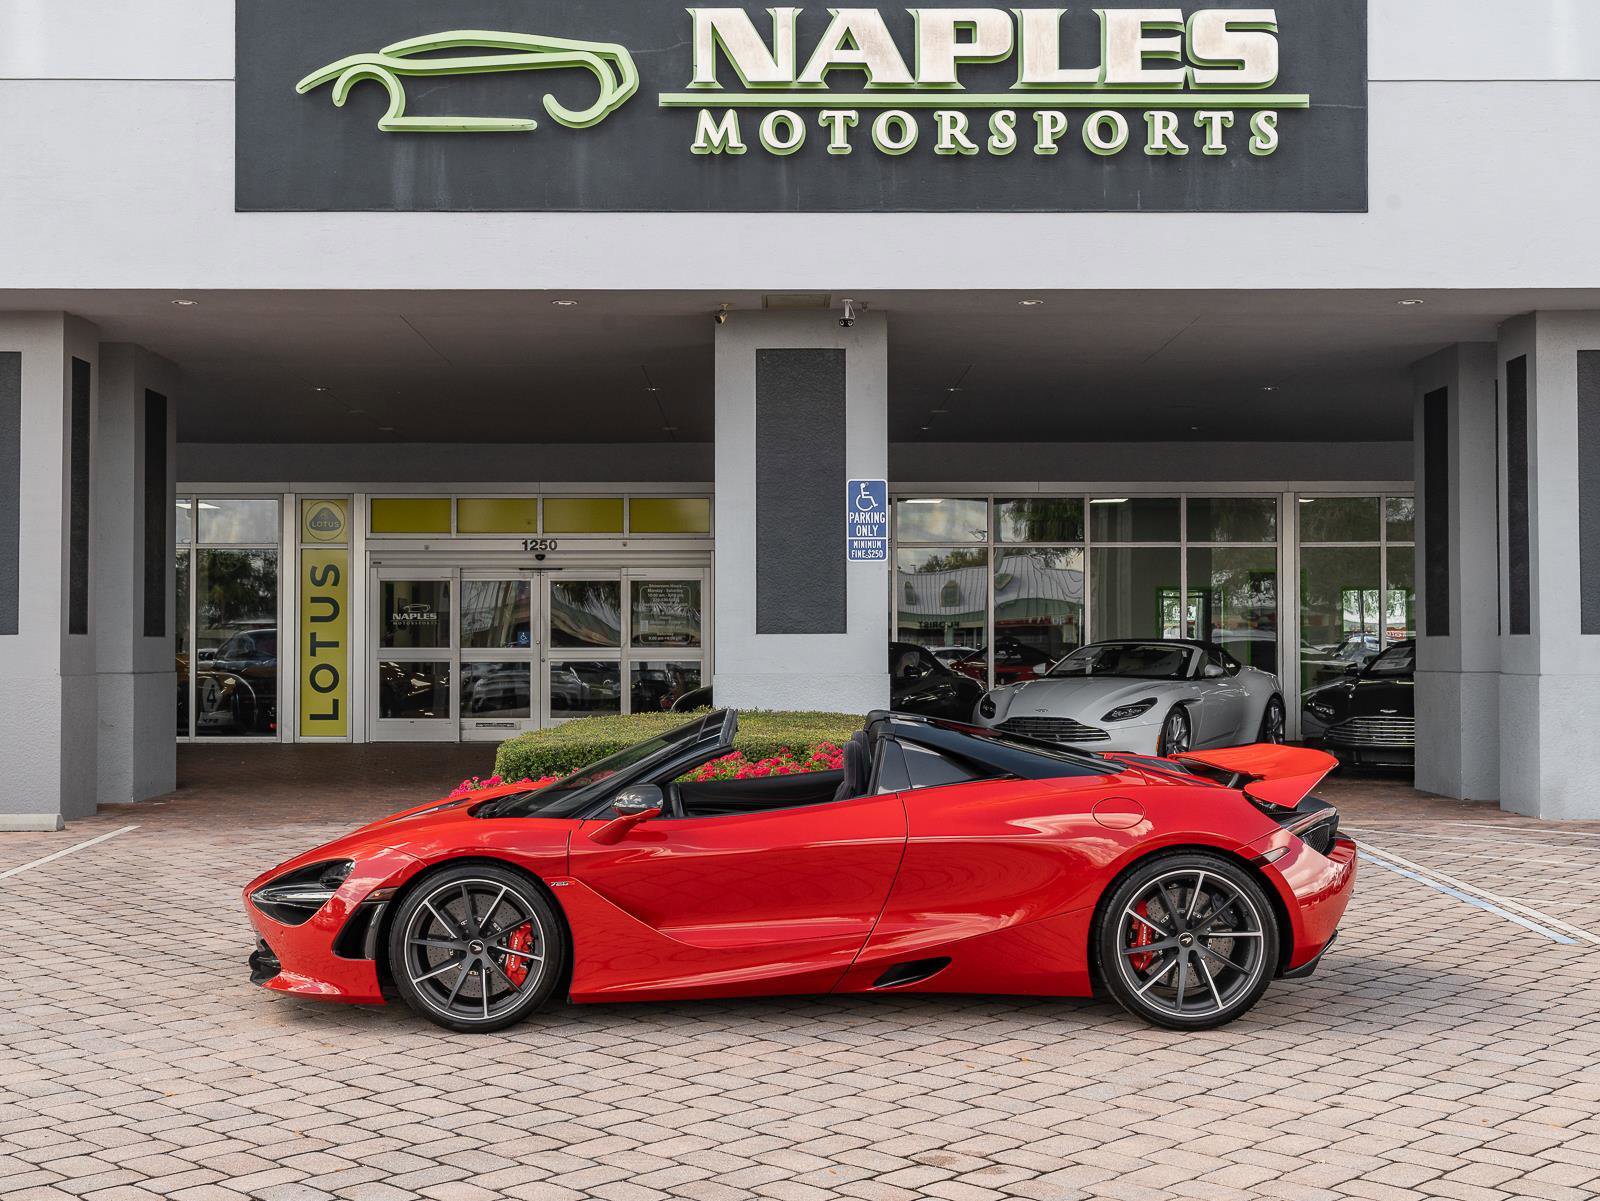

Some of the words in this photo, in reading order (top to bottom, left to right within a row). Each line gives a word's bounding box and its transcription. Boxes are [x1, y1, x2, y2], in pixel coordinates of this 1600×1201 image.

[685, 7, 1278, 90] NAPLES
[690, 108, 1279, 156] MOTORSPORTS
[849, 512, 885, 523] PARKING
[856, 525, 878, 536] ONLY
[521, 540, 557, 551] 1250
[311, 564, 340, 721] LOTUS
